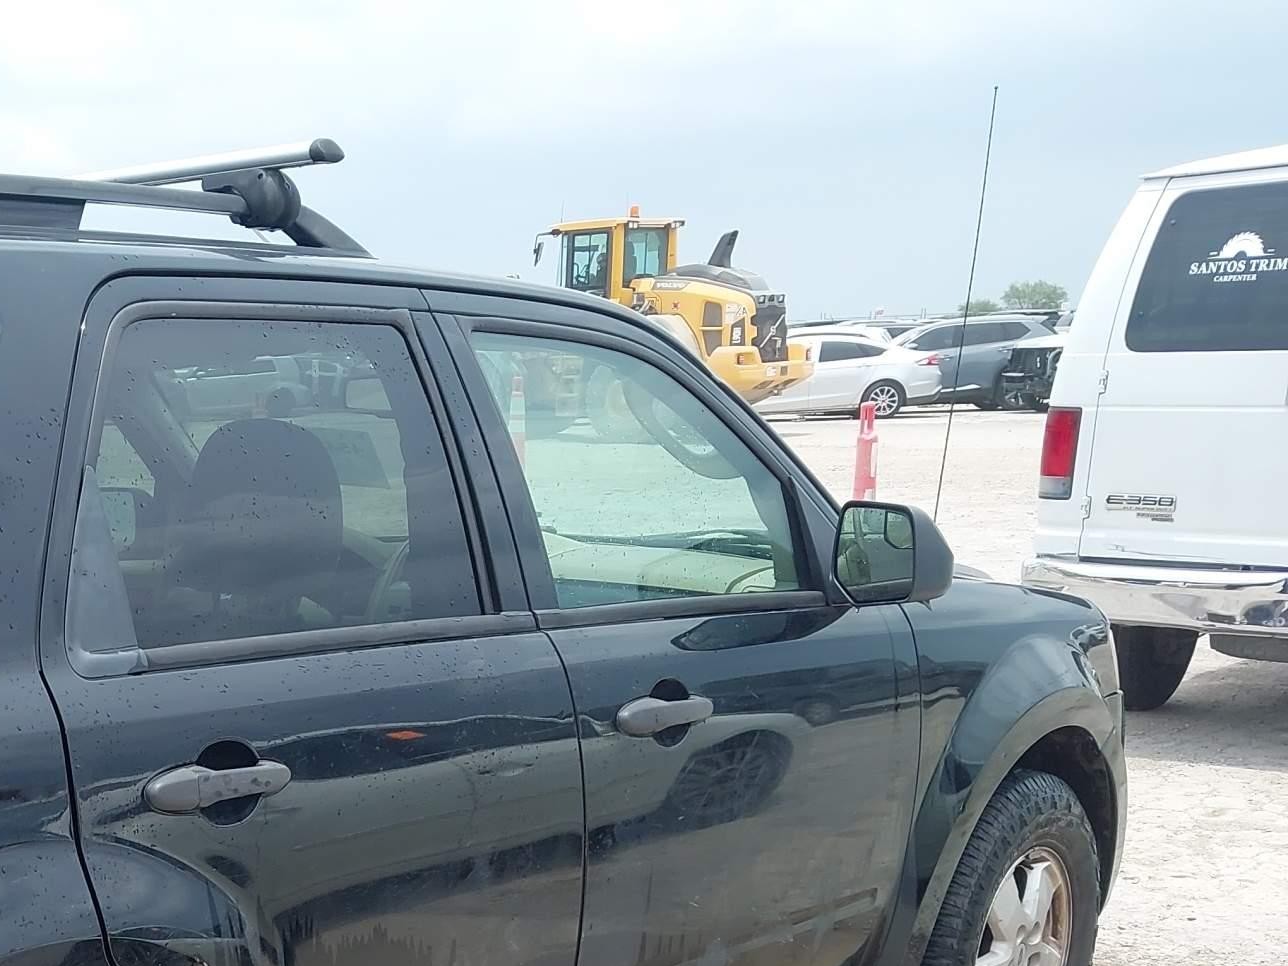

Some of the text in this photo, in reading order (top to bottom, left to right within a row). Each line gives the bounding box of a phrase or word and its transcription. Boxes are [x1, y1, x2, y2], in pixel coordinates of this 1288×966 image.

[1189, 257, 1288, 274] SANTOS TRIM
[1214, 274, 1257, 282] CARPENTER
[1106, 495, 1175, 507] E-350
